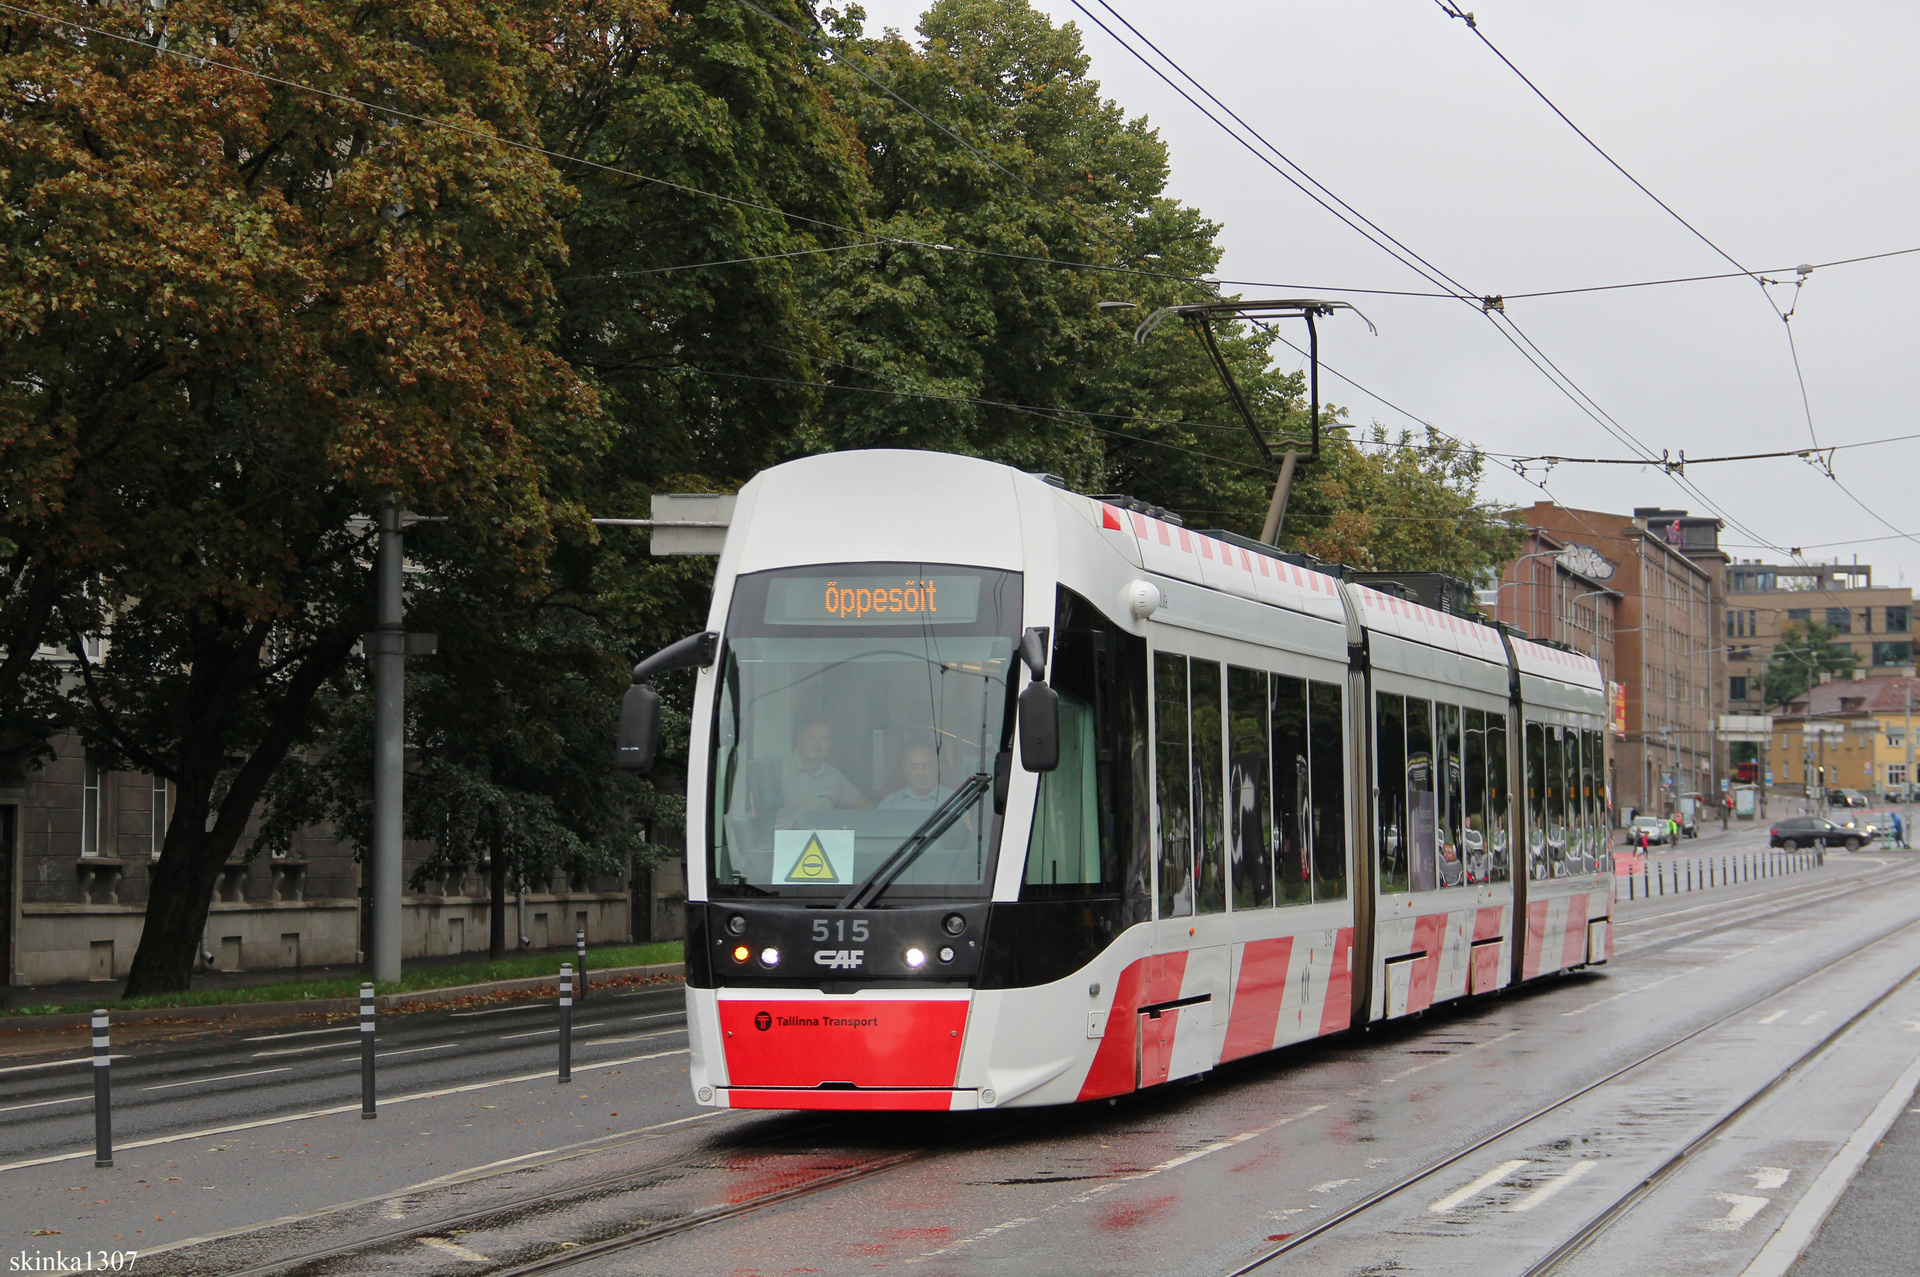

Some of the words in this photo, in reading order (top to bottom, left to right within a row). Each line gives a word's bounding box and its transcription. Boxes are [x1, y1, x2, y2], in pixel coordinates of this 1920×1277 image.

[825, 580, 937, 618] õppesõit
[812, 919, 869, 942] 515
[814, 950, 864, 969] CAF
[776, 1016, 819, 1027] Tallinna
[823, 1016, 878, 1028] Transport
